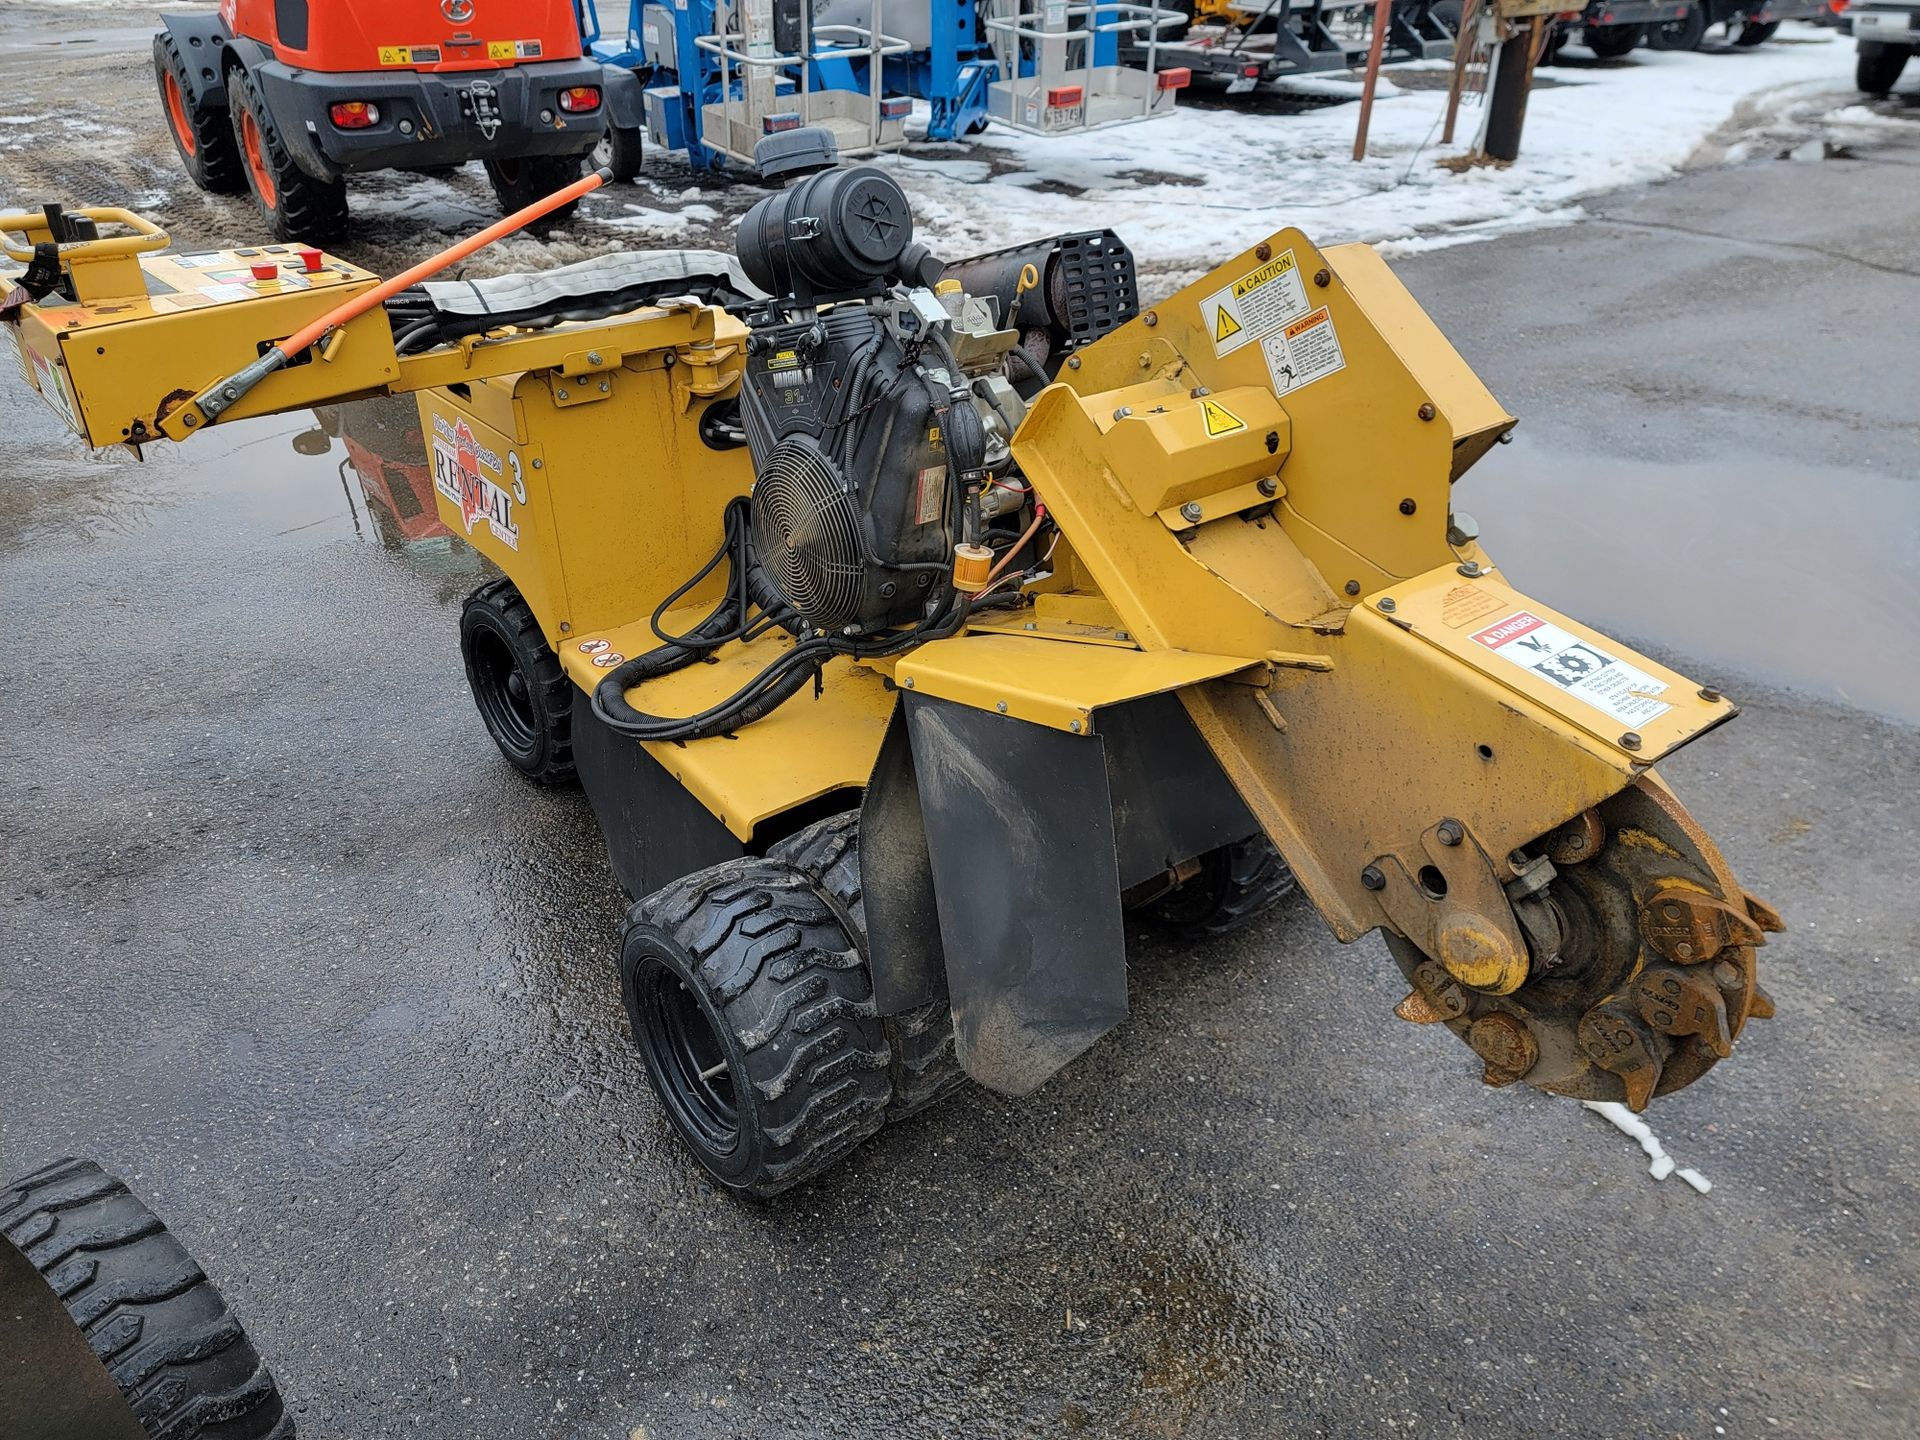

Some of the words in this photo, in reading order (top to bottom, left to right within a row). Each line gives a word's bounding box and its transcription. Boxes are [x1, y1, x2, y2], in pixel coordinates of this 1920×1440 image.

[1246, 257, 1291, 289] CAUTION
[1295, 313, 1324, 332] WARNING
[773, 369, 813, 388] VANGUAD
[436, 448, 518, 535] RENTAL
[509, 450, 526, 505] 3
[1495, 616, 1538, 640] DANGER
